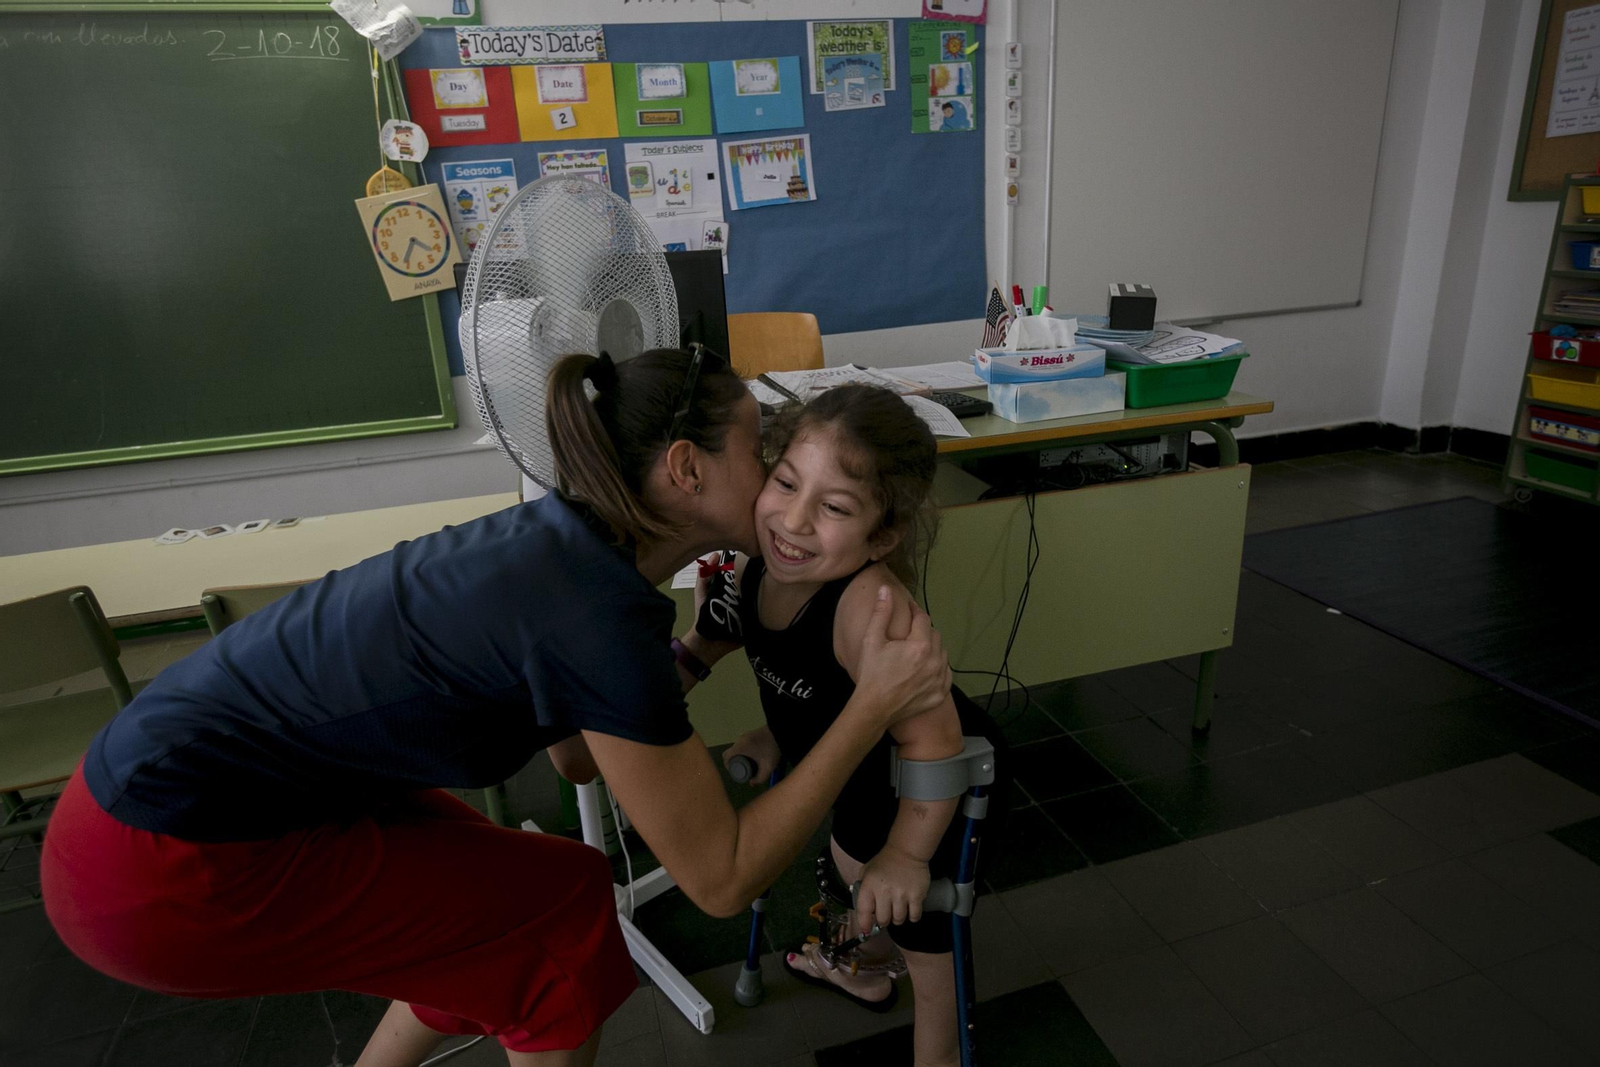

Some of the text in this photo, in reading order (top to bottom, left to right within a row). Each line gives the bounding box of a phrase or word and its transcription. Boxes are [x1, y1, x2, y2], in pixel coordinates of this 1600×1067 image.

[830, 25, 874, 39] Today's
[203, 25, 340, 57] 2-10-18
[468, 31, 595, 57] Today's Date
[819, 39, 885, 53] weather is:
[649, 77, 678, 88] Month
[750, 73, 768, 82] Year
[449, 81, 468, 93] Day
[552, 79, 574, 90] Date
[448, 117, 480, 129] Tuesday
[559, 113, 568, 124] 2
[641, 144, 704, 156] Today's Subjects
[455, 164, 503, 177] Seasons
[396, 208, 410, 218] 12
[416, 210, 423, 220] 1
[385, 216, 397, 226] 11
[428, 219, 436, 228] 2
[379, 229, 393, 238] 10
[433, 230, 440, 239] 3
[381, 241, 389, 250] 9
[433, 244, 441, 253] 4
[391, 252, 399, 262] 8
[427, 254, 434, 264] 5
[418, 262, 425, 271] 6
[414, 279, 442, 291] ANAYA
[1030, 353, 1064, 367] Bissú
[762, 667, 787, 695] say
[790, 678, 813, 700] hi
